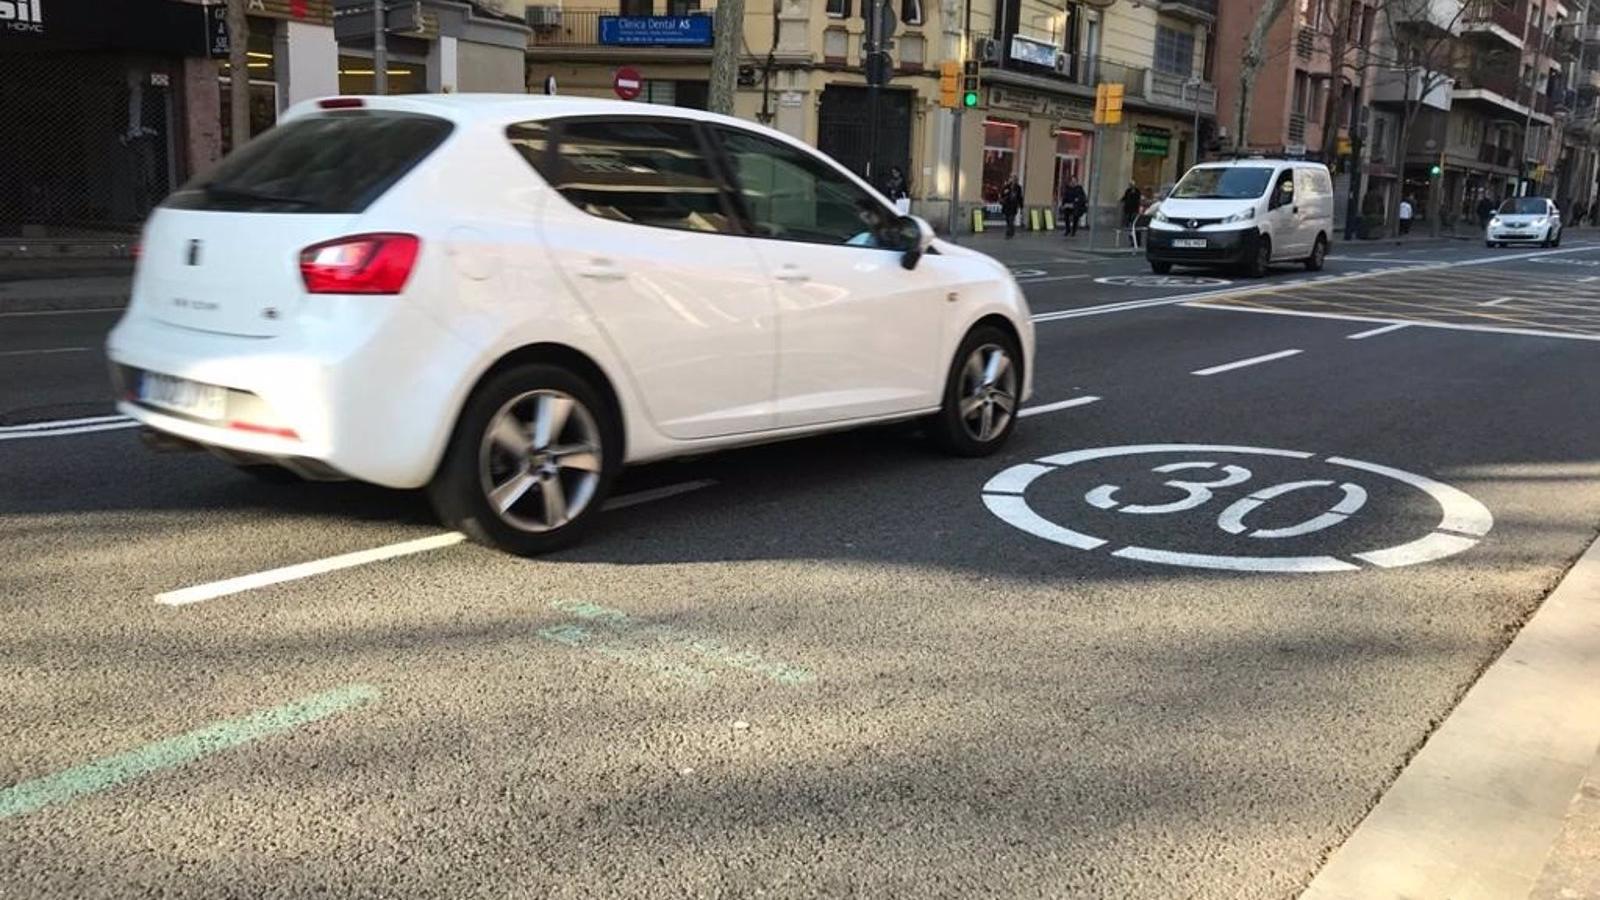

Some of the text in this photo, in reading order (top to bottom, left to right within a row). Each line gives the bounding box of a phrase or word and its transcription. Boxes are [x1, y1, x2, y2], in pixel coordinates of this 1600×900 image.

[648, 18, 676, 30] Dental
[679, 19, 691, 30] AS
[1085, 461, 1367, 537] 30
